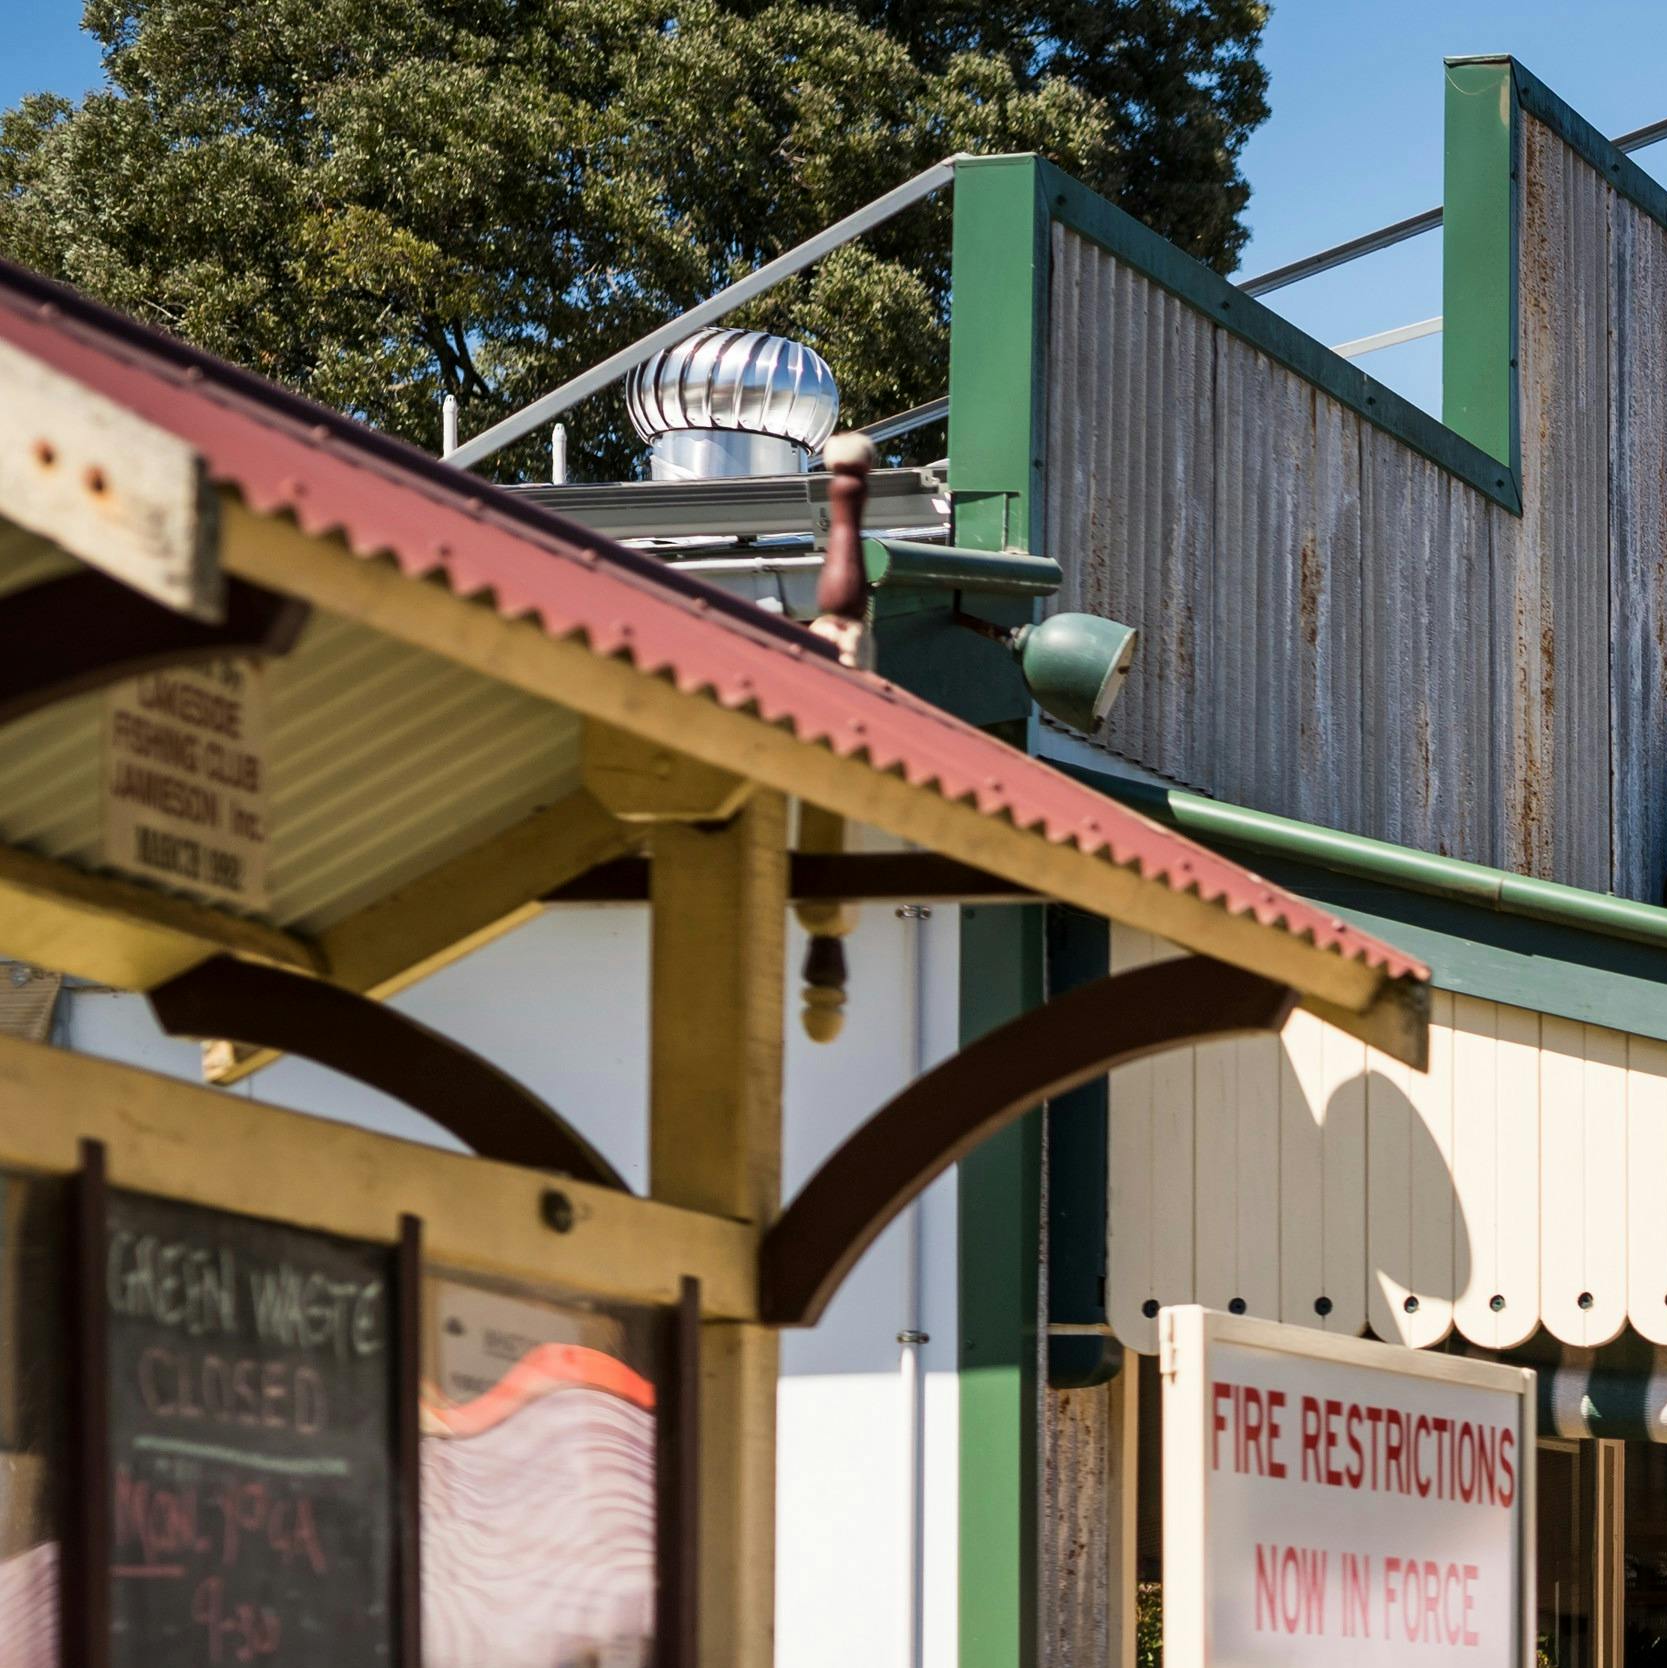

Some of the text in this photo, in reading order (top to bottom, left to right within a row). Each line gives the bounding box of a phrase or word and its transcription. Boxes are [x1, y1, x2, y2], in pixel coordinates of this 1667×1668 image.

[139, 1347, 328, 1434] CLOSED
[1212, 1381, 1515, 1509] FIRE RESTRICTIONS
[1255, 1542, 1479, 1646] NOW IN FORCE
